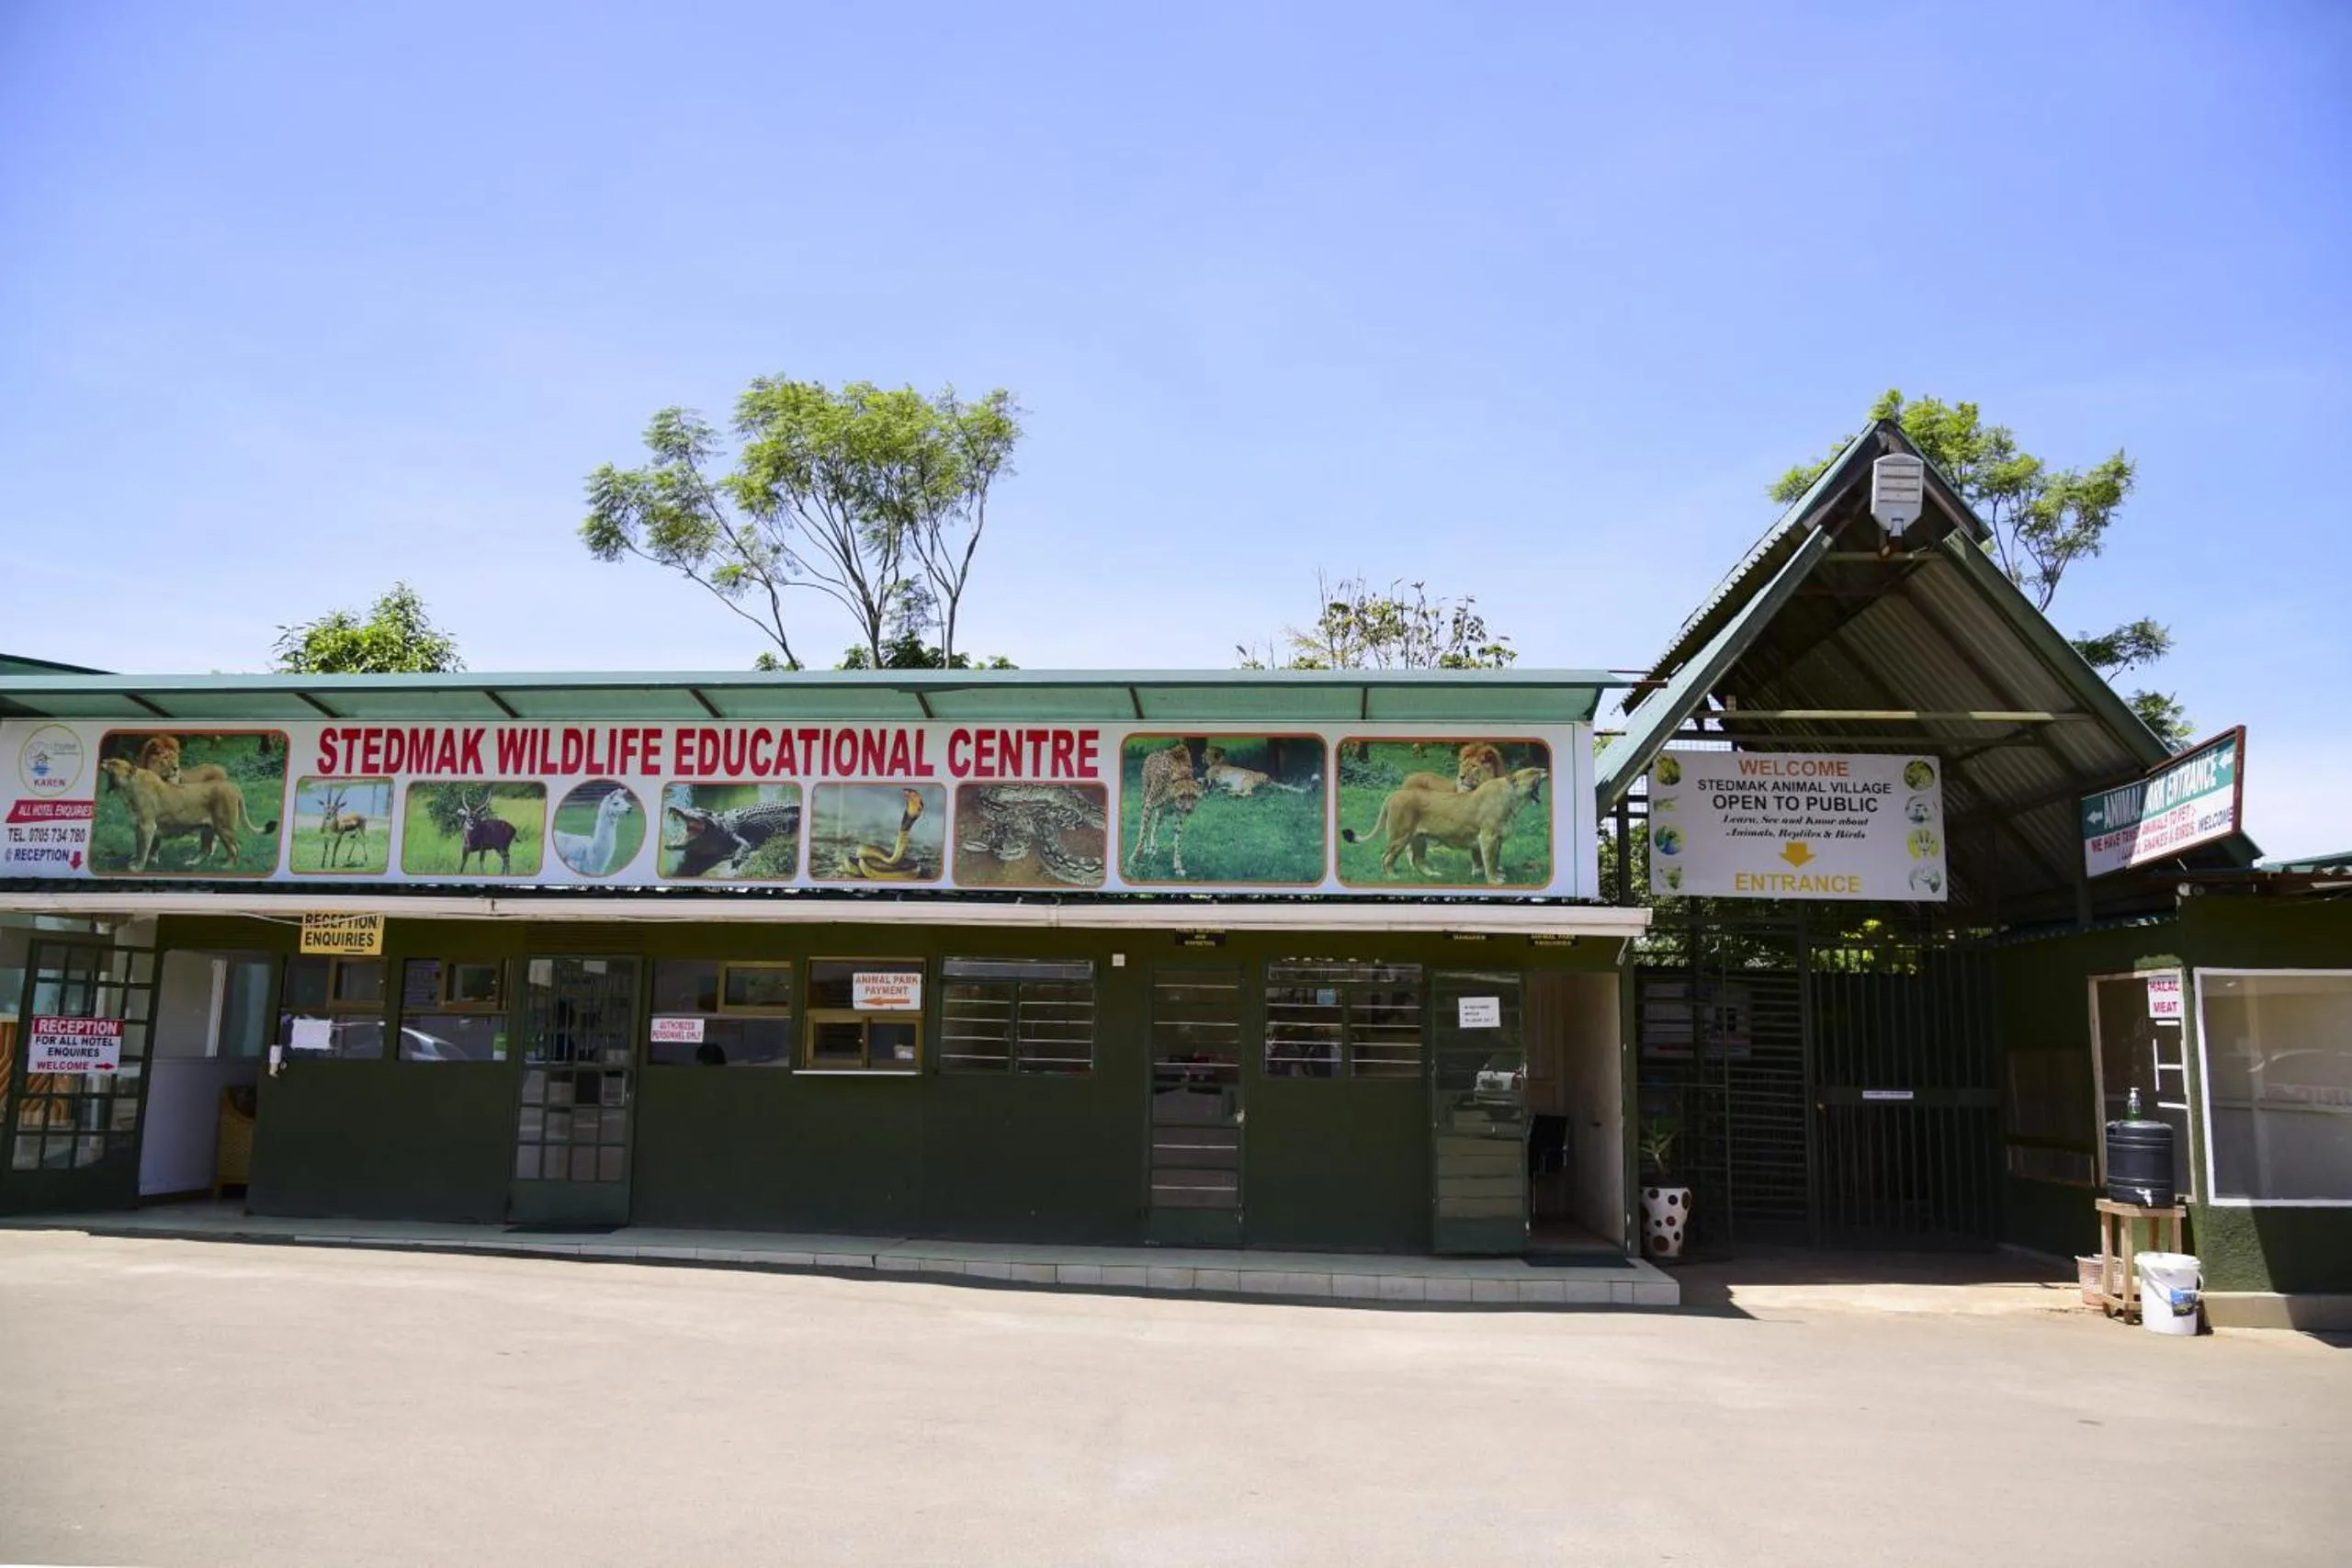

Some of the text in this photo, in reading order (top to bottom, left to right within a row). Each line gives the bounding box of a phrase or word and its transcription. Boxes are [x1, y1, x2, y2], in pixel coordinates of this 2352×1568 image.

[316, 728, 1100, 778] STEDMAK WILDLIFE EDUCATIONAL CENTRE
[1738, 760, 1849, 777] WELCOME
[34, 778, 66, 787] KAREN
[1698, 779, 1893, 795] STEDMAK ANIMAL VILLAGE
[2103, 785, 2141, 829] ANIMAL
[2166, 749, 2217, 806] ENTRANCE
[1713, 795, 1879, 813] OPEN TO PUBLIC
[1761, 815, 1778, 824] See
[1781, 815, 1804, 825] and
[1838, 817, 1869, 826] about
[51, 828, 68, 842] 734
[1778, 829, 1821, 840] Reptiles
[1823, 829, 1832, 839] &
[1835, 829, 1866, 839] Birds
[14, 848, 70, 862] RECEPTION
[1736, 873, 1861, 893] ENTRANCE
[305, 914, 378, 929] RECEPTION
[305, 931, 375, 946] ENQUIRIES
[855, 975, 919, 985] ANIMAL PARK
[865, 986, 909, 995] PAYMENT
[39, 1019, 118, 1035] RECEPTION
[36, 1036, 114, 1046] FOR ALL HOTEL
[48, 1048, 100, 1057] ENQUIRES
[37, 1061, 89, 1070] WELCOME
